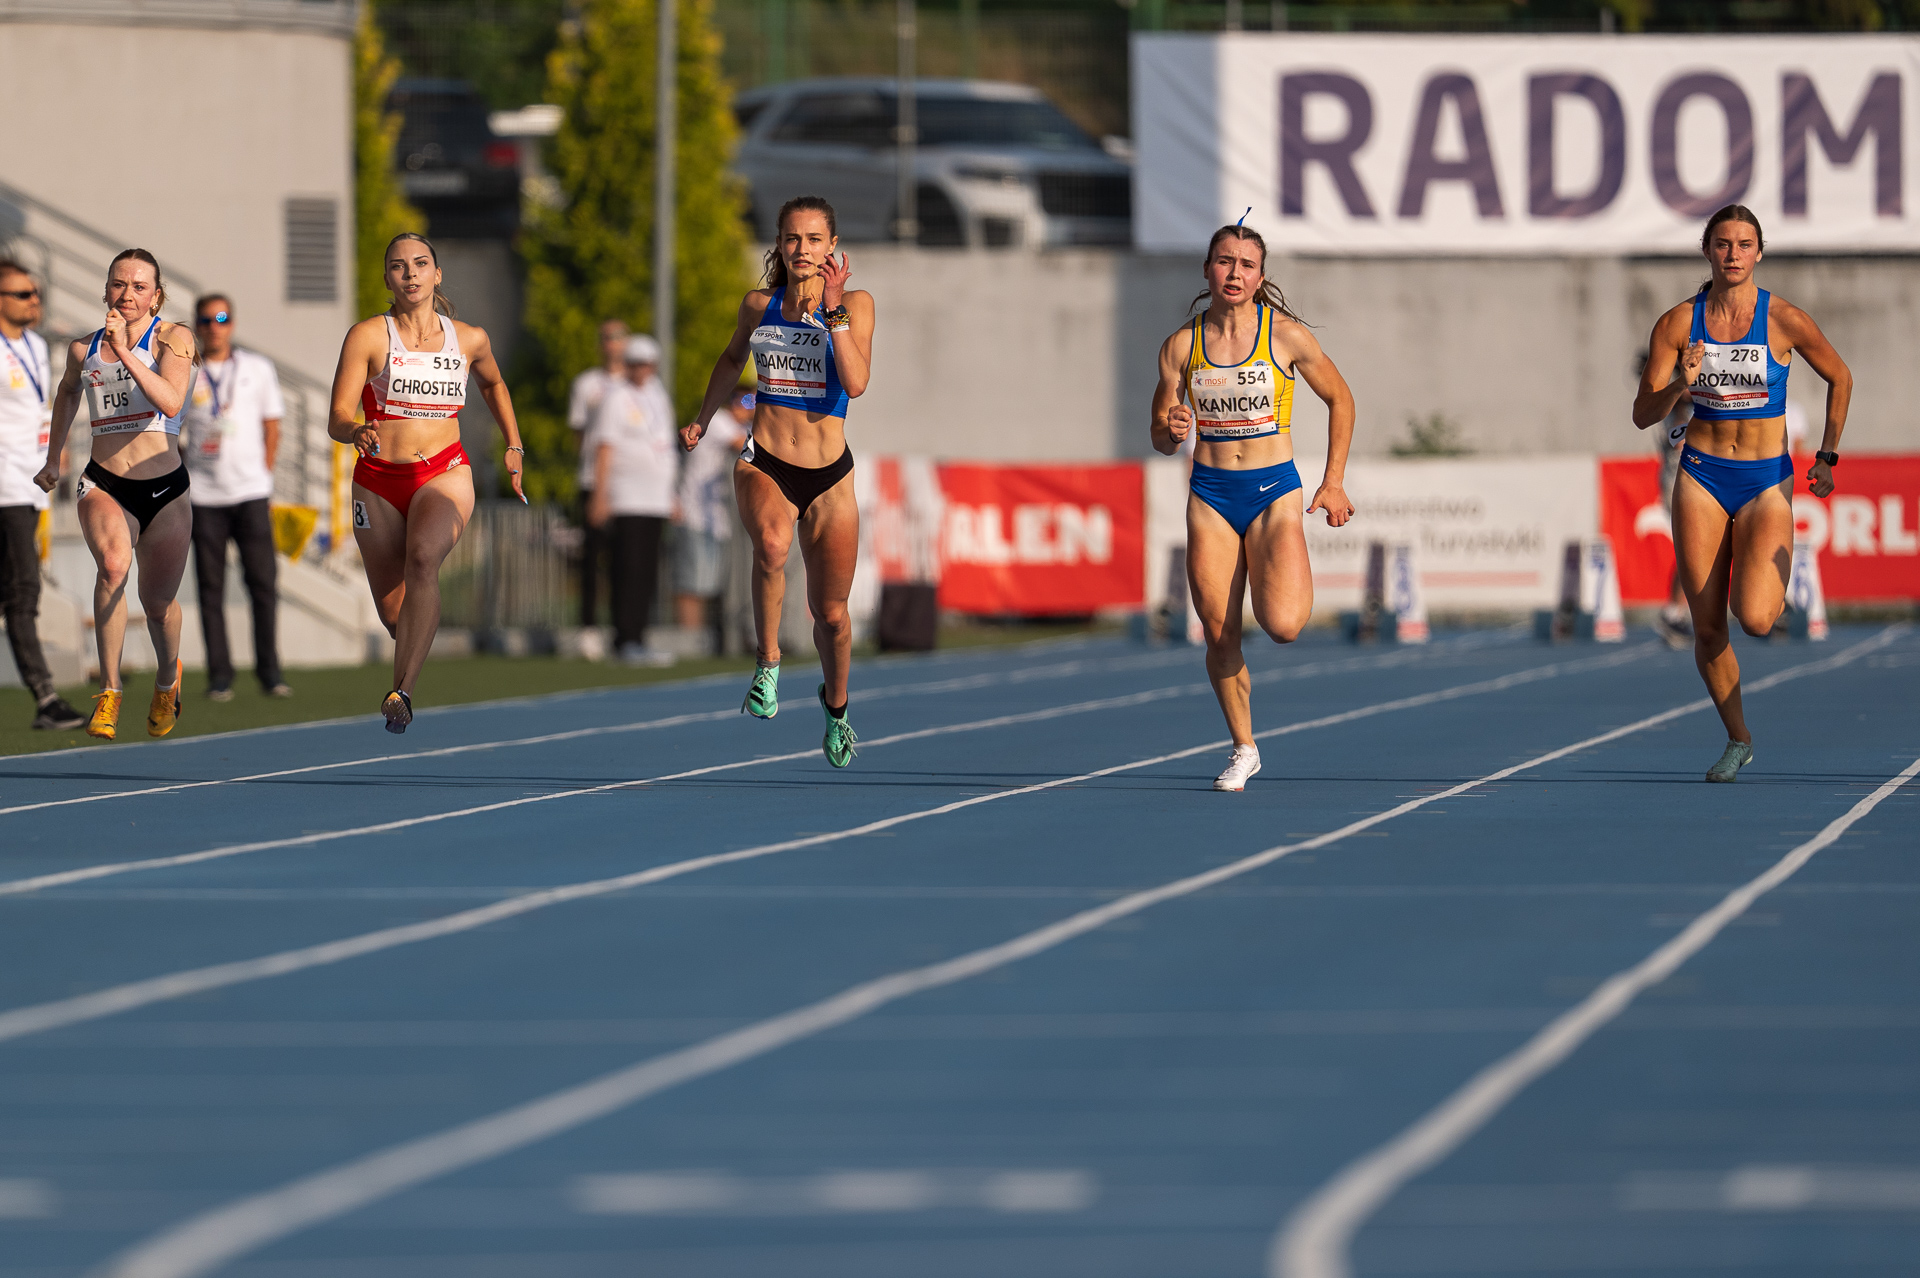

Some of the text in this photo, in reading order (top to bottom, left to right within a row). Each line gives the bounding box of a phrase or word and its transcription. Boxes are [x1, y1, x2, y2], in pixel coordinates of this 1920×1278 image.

[1276, 69, 1905, 218] RADOM
[791, 333, 820, 346] 276
[756, 352, 822, 373] ADAMCZYK
[1730, 349, 1759, 362] 278
[433, 356, 461, 370] 519
[1204, 376, 1227, 386] mosir
[1237, 371, 1267, 385] 554
[392, 378, 463, 396] CHROSTEK
[764, 386, 788, 394] RADOM
[103, 392, 129, 409] FUS
[1198, 395, 1270, 412] KANICKA
[1707, 400, 1731, 408] RADOM
[403, 410, 430, 418] RADOM
[100, 422, 139, 433] RADOM 2024
[355, 502, 365, 527] 8
